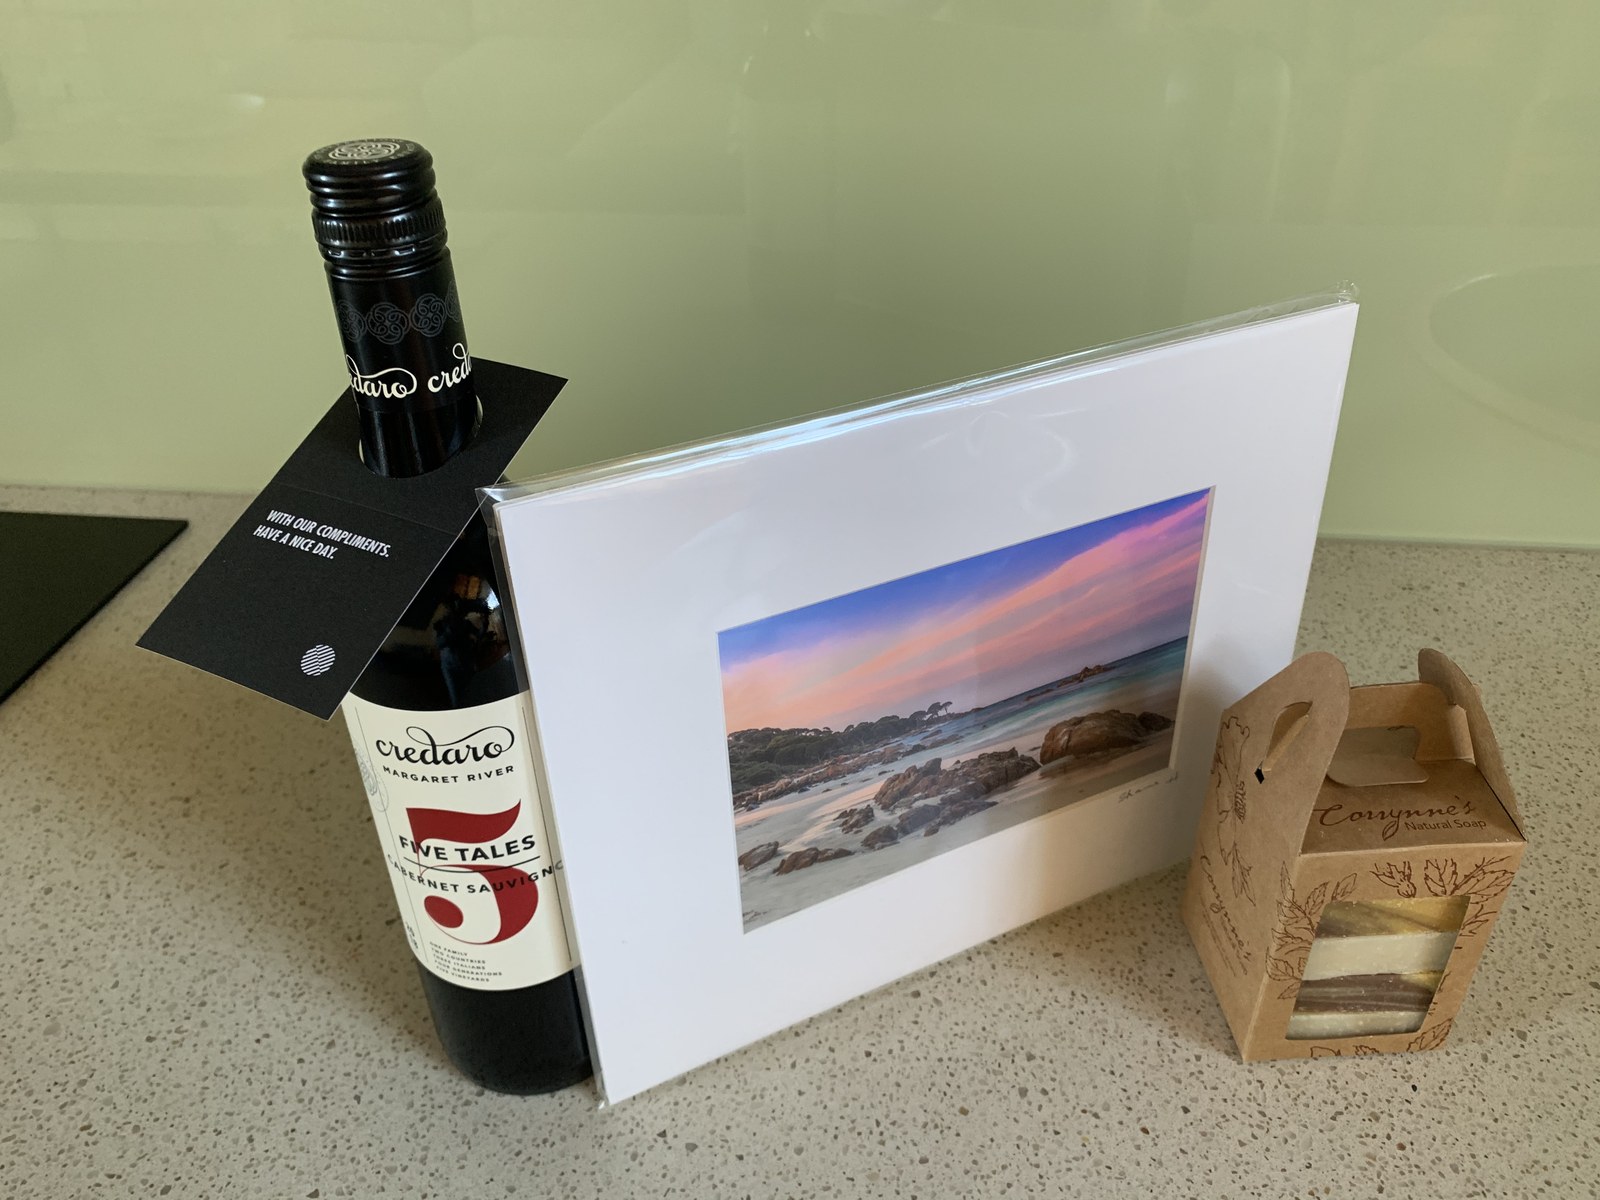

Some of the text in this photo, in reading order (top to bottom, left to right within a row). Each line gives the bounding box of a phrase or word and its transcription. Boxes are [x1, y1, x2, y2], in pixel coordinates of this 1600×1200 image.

[346, 354, 417, 398] daro
[253, 524, 338, 560] HAVE A NICE DAY.
[266, 509, 391, 558] WITH OUR COMPLIMENTS.
[376, 725, 515, 765] credaro
[383, 765, 515, 783] MARGARET RIVER
[1405, 818, 1487, 832] Natural Soap
[399, 834, 536, 862] FIVE TALES
[387, 854, 459, 892] CABERNET
[444, 947, 468, 956] FAMILY
[446, 954, 486, 964] COUNTRIES
[452, 967, 502, 976] GENERATIONS
[453, 960, 485, 970] ITALIANS
[451, 972, 489, 982] VINEYARDS
